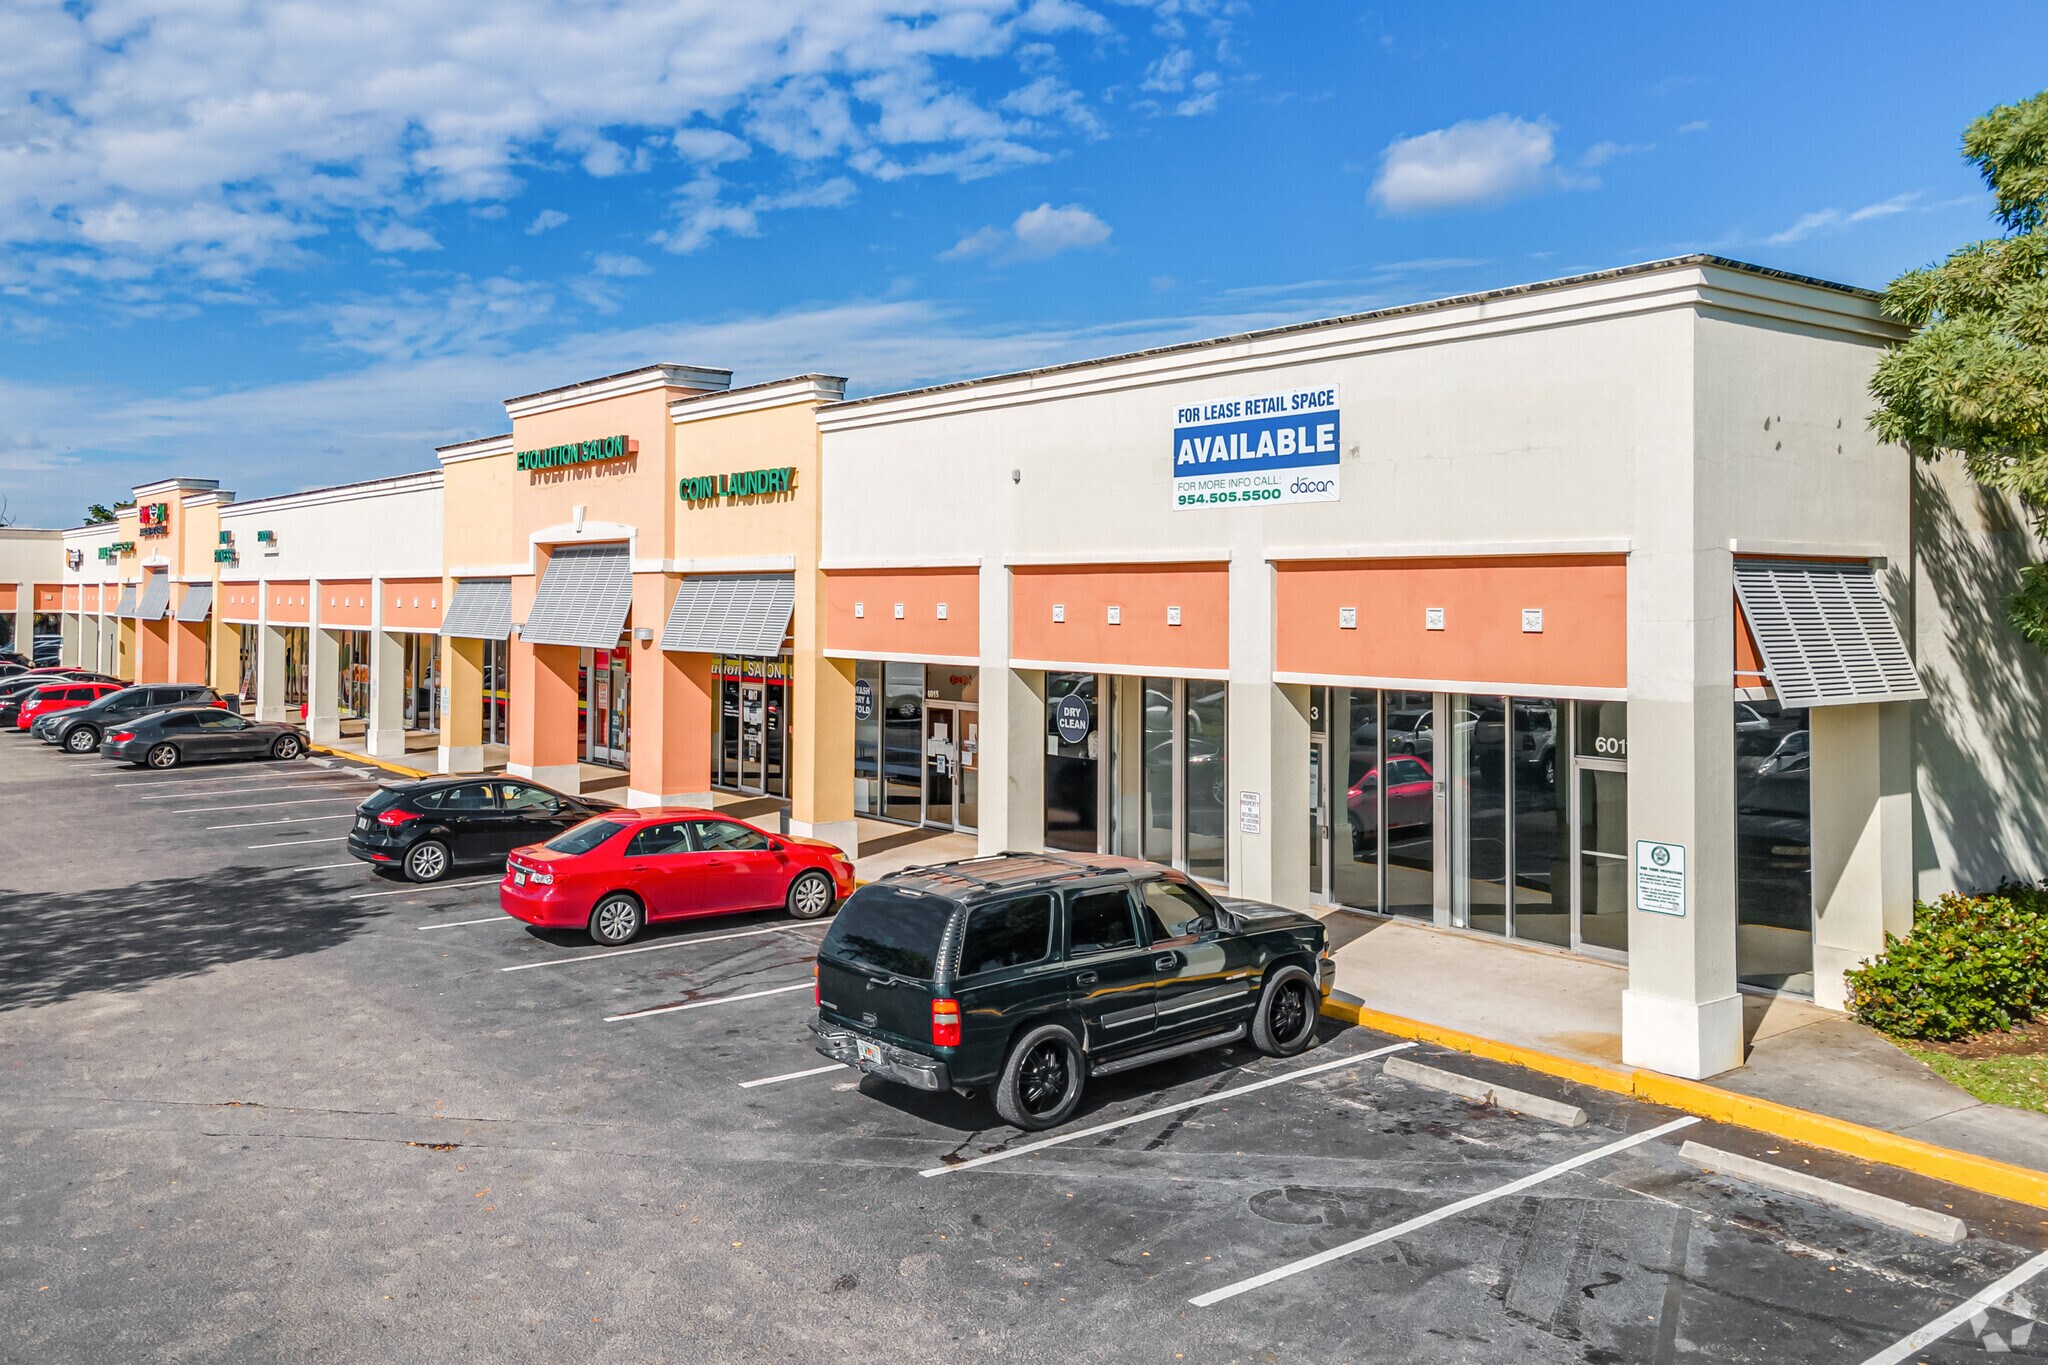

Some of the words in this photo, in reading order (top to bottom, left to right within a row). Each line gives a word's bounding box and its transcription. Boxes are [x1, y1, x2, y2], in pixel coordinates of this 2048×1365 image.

[1178, 407, 1200, 424] FOR
[1204, 402, 1241, 421] LEASE
[1245, 396, 1287, 416] RETAIL
[1291, 389, 1335, 410] SPACE
[517, 443, 579, 471] EVOLUTION
[581, 435, 624, 462] SALON
[1177, 423, 1336, 466] AVAILABLE
[679, 474, 713, 501] COIN
[718, 467, 791, 497] LAUNDRY
[1177, 482, 1197, 492] FOR
[1199, 479, 1226, 491] MORE
[1228, 477, 1251, 489] INFO
[1254, 475, 1282, 487] CALL:
[1178, 488, 1282, 505] 954.505.5500
[1064, 707, 1081, 718] DRY
[1059, 718, 1086, 730] CLEAN
[1595, 736, 1627, 754] 601
